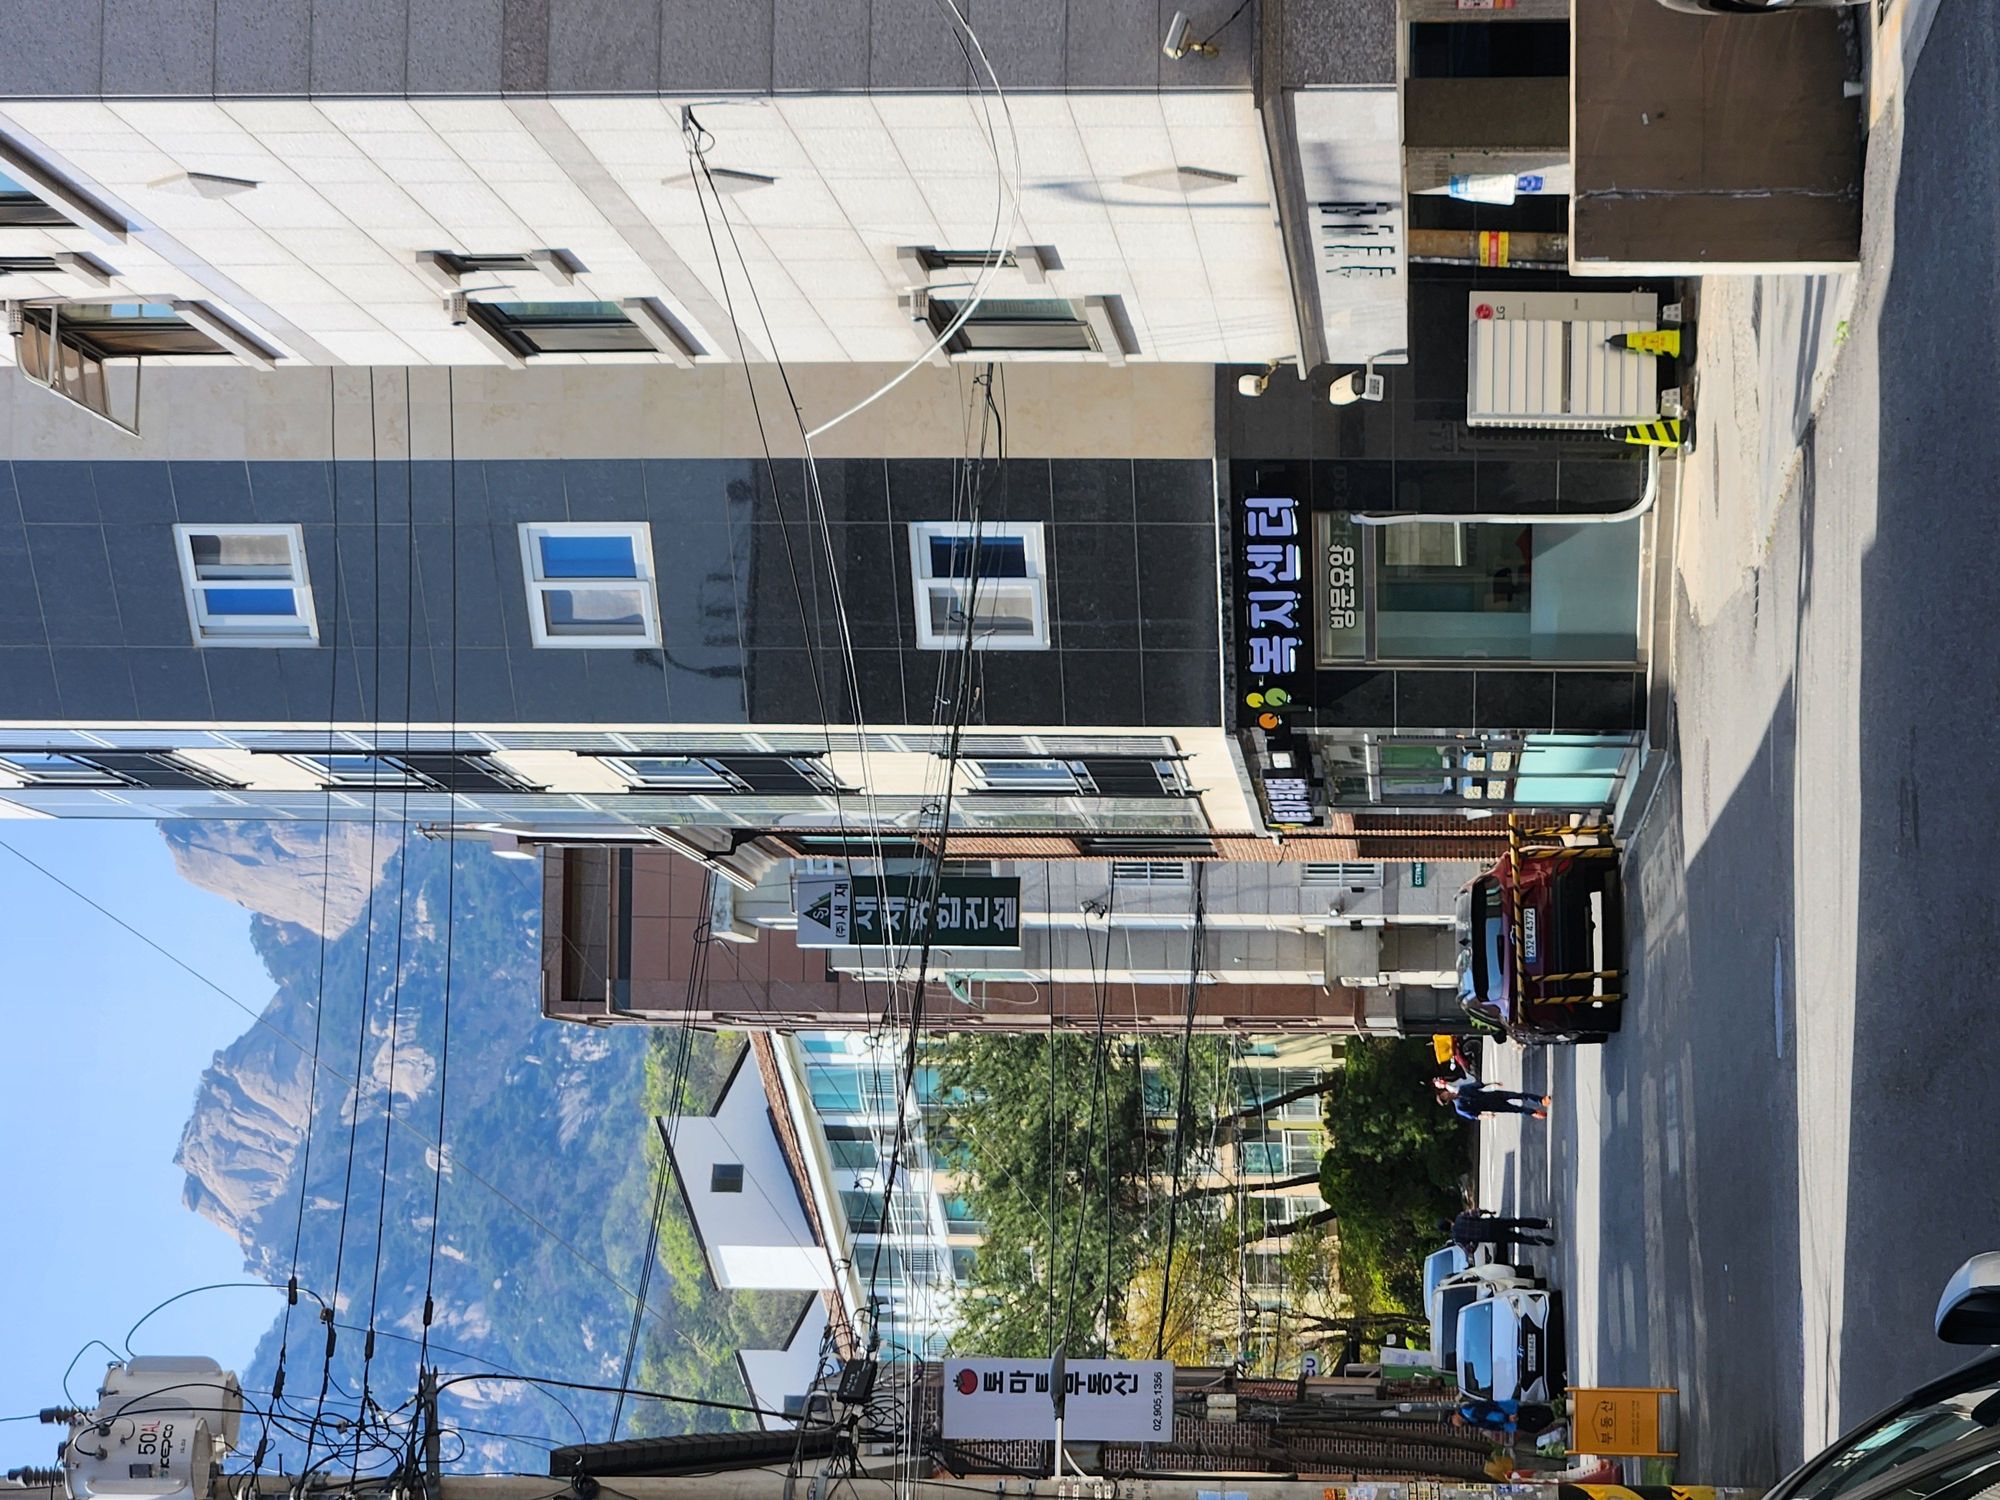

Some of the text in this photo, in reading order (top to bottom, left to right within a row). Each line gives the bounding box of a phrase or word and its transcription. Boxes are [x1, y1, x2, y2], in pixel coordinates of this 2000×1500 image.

[1496, 305, 1505, 320] LG
[1244, 497, 1301, 675] 복지센터
[1328, 544, 1356, 629] 방문요양
[1600, 1400, 1613, 1445] 부동산
